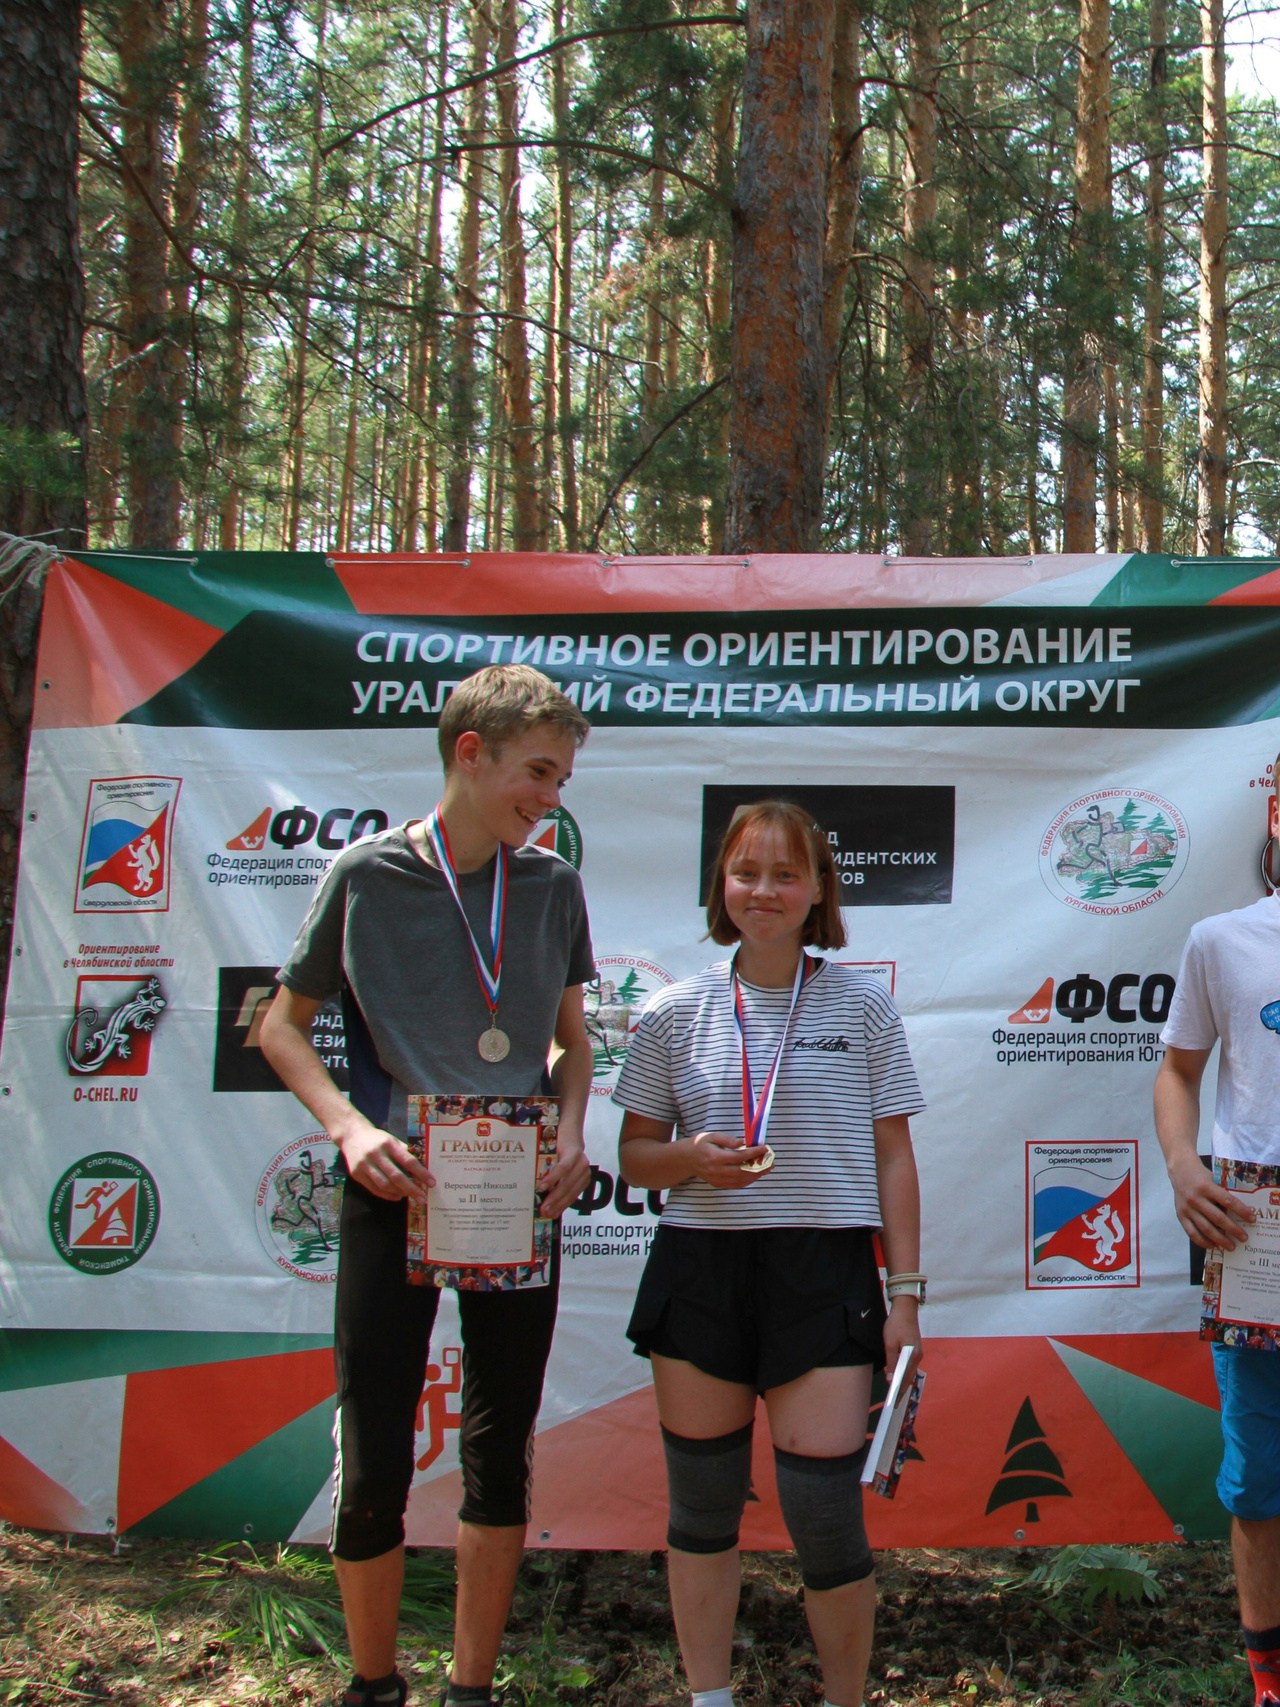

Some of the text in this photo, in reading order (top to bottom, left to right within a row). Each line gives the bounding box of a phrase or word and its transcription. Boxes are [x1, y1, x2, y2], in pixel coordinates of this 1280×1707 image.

[356, 627, 1133, 667] СПОРТИВНОЕ ОРИЕНТИРОВАНИЕ
[352, 674, 1140, 719] УРАЛИЙ ФЕДЕРАЛЬНЫЙ ОКРУГ
[1041, 790, 1186, 857] ФЕДЕРАЦИЯ СПОРТИВНОГО ОРИЕНТИРОВАНИЯ
[562, 820, 577, 867] ОРИЕНТИРО
[207, 852, 293, 872] Федерация
[832, 852, 937, 867] ИДЕНТСКИХ
[208, 872, 318, 889] ориентирован
[83, 898, 158, 909] Свердловской области
[1064, 889, 1164, 915] КУРГАНСКОЙ ОБЛАСТИ
[79, 943, 160, 956] Ориентирование
[64, 957, 174, 968] в Челябинской области
[1055, 973, 1176, 1023] ФСО
[1263, 1007, 1279, 1018] Take
[993, 1028, 1162, 1048] Федерация спортив
[997, 1048, 1134, 1065] ориентирования
[73, 1087, 138, 1102] O-CHEL.RU
[441, 1140, 525, 1153] ГРАМОТА
[1034, 1147, 1129, 1157] Федерация спортивного
[1048, 1157, 1112, 1165] ориентирования
[257, 1133, 332, 1207] ФЕДЕРАЦИЯ СПОРТИВНО
[569, 1165, 665, 1216] ФС
[53, 1157, 156, 1269] ФЕДЕРАЦИЯ СПОРТИВНОГО ОРИЕНТИРОВАНИЯ ТЮМЕНСКОЙ ОБЛАСТИ
[596, 1225, 660, 1241] спорти
[562, 1243, 640, 1259] ирования
[277, 1256, 328, 1282] КУРГАНСКОЙ
[1259, 1258, 1269, 1267] III
[1037, 1274, 1126, 1284] Свердловской области
